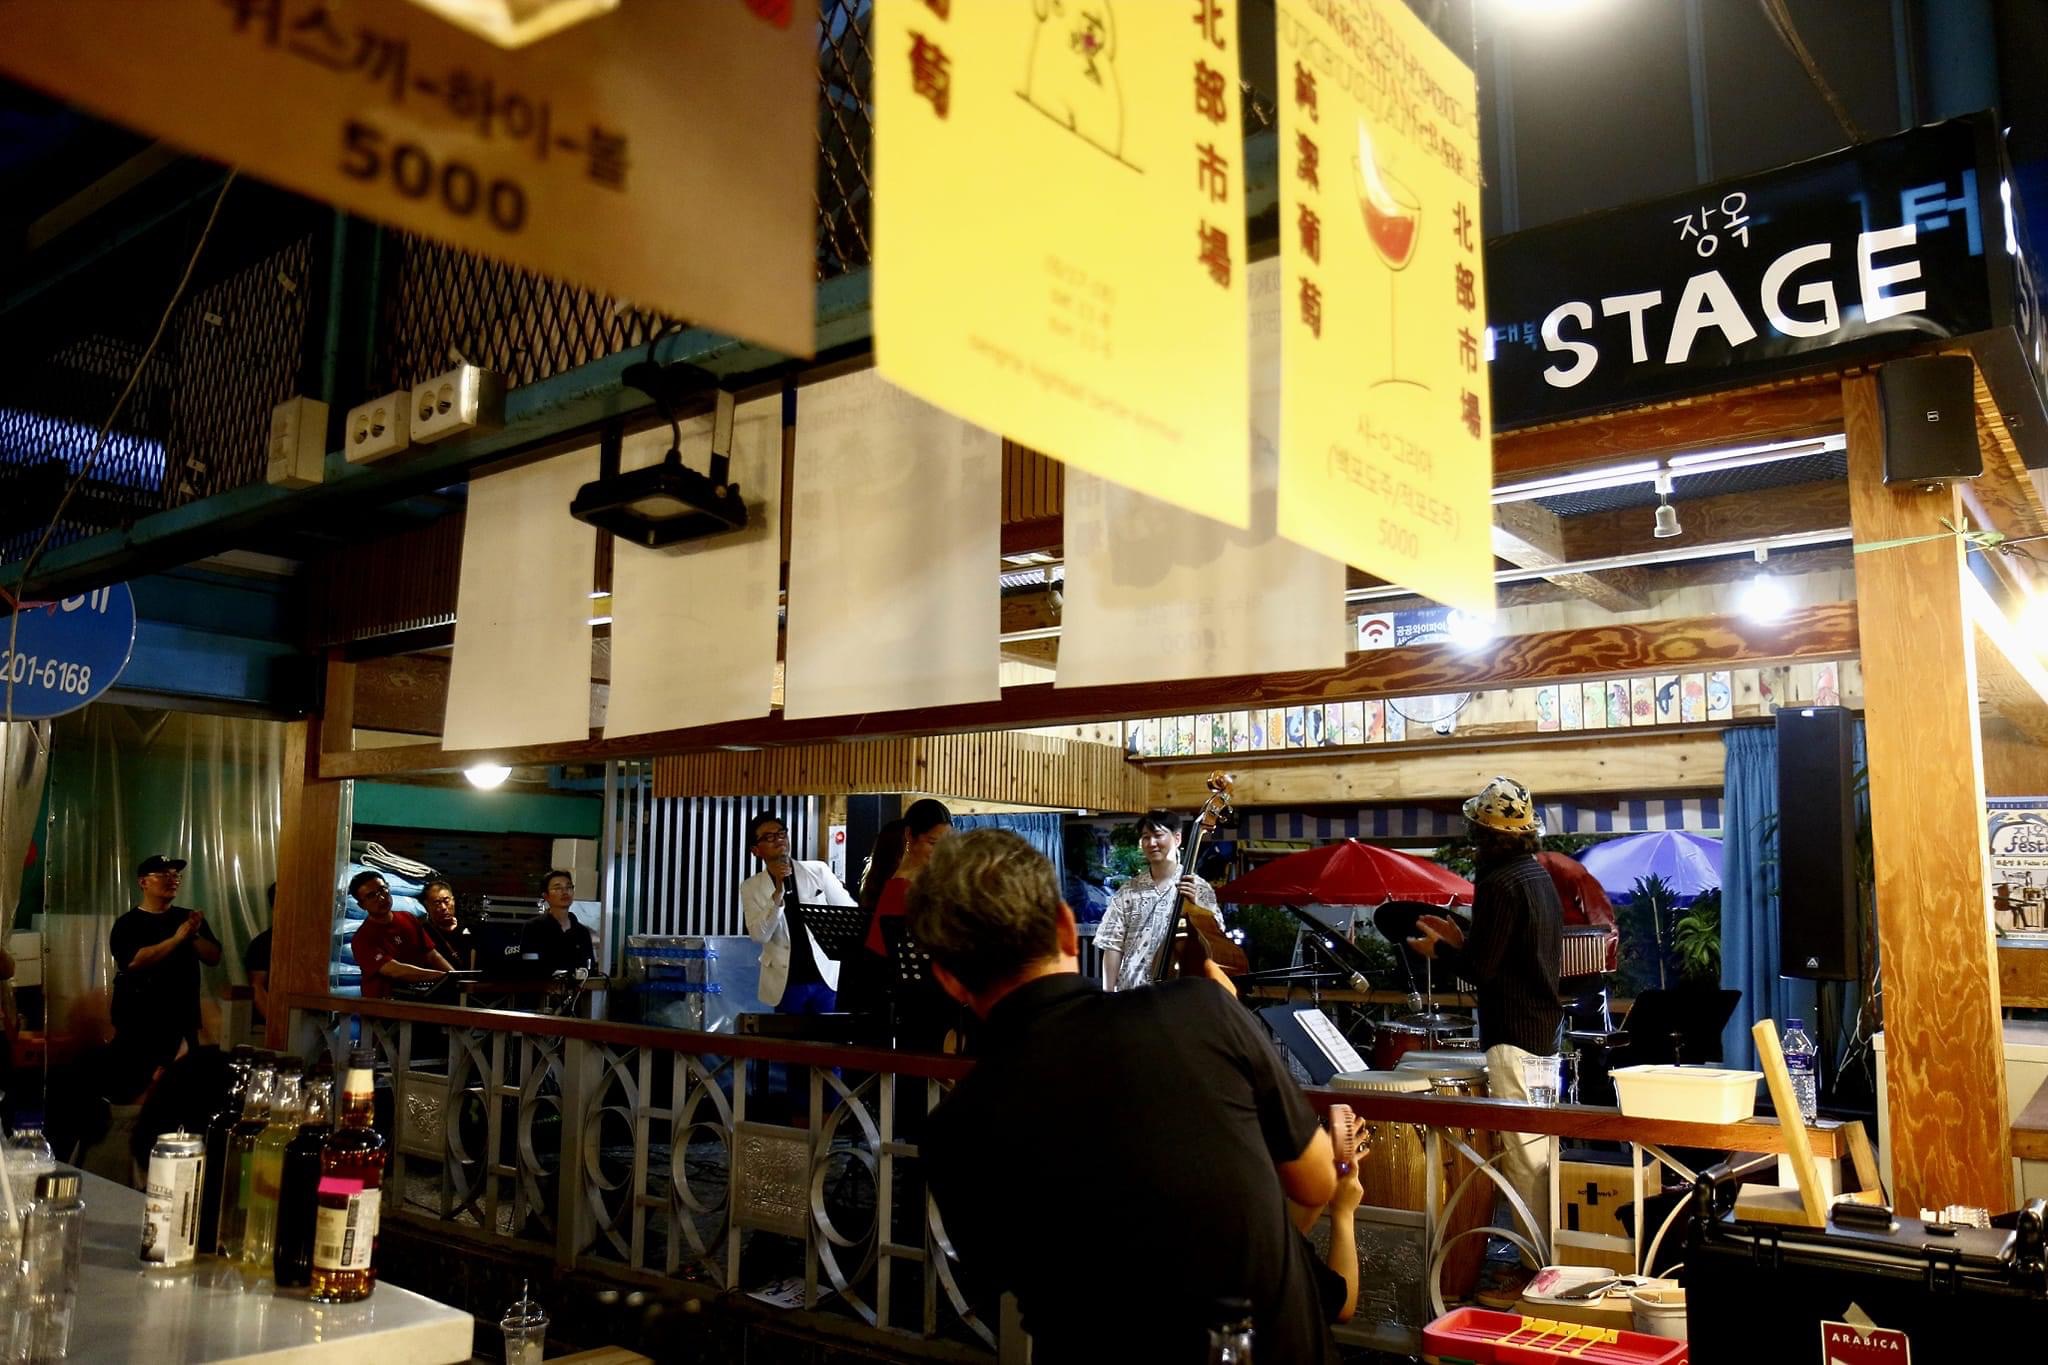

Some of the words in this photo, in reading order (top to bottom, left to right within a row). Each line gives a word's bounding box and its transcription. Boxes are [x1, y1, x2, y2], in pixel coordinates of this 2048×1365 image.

[338, 118, 530, 234] 5000
[1673, 191, 1751, 258] 장옥
[1453, 201, 1481, 440] 北部市場
[1540, 224, 1926, 388] STAGE
[0, 650, 91, 695] 201-6168
[1832, 1332, 1899, 1351] ARABICA
